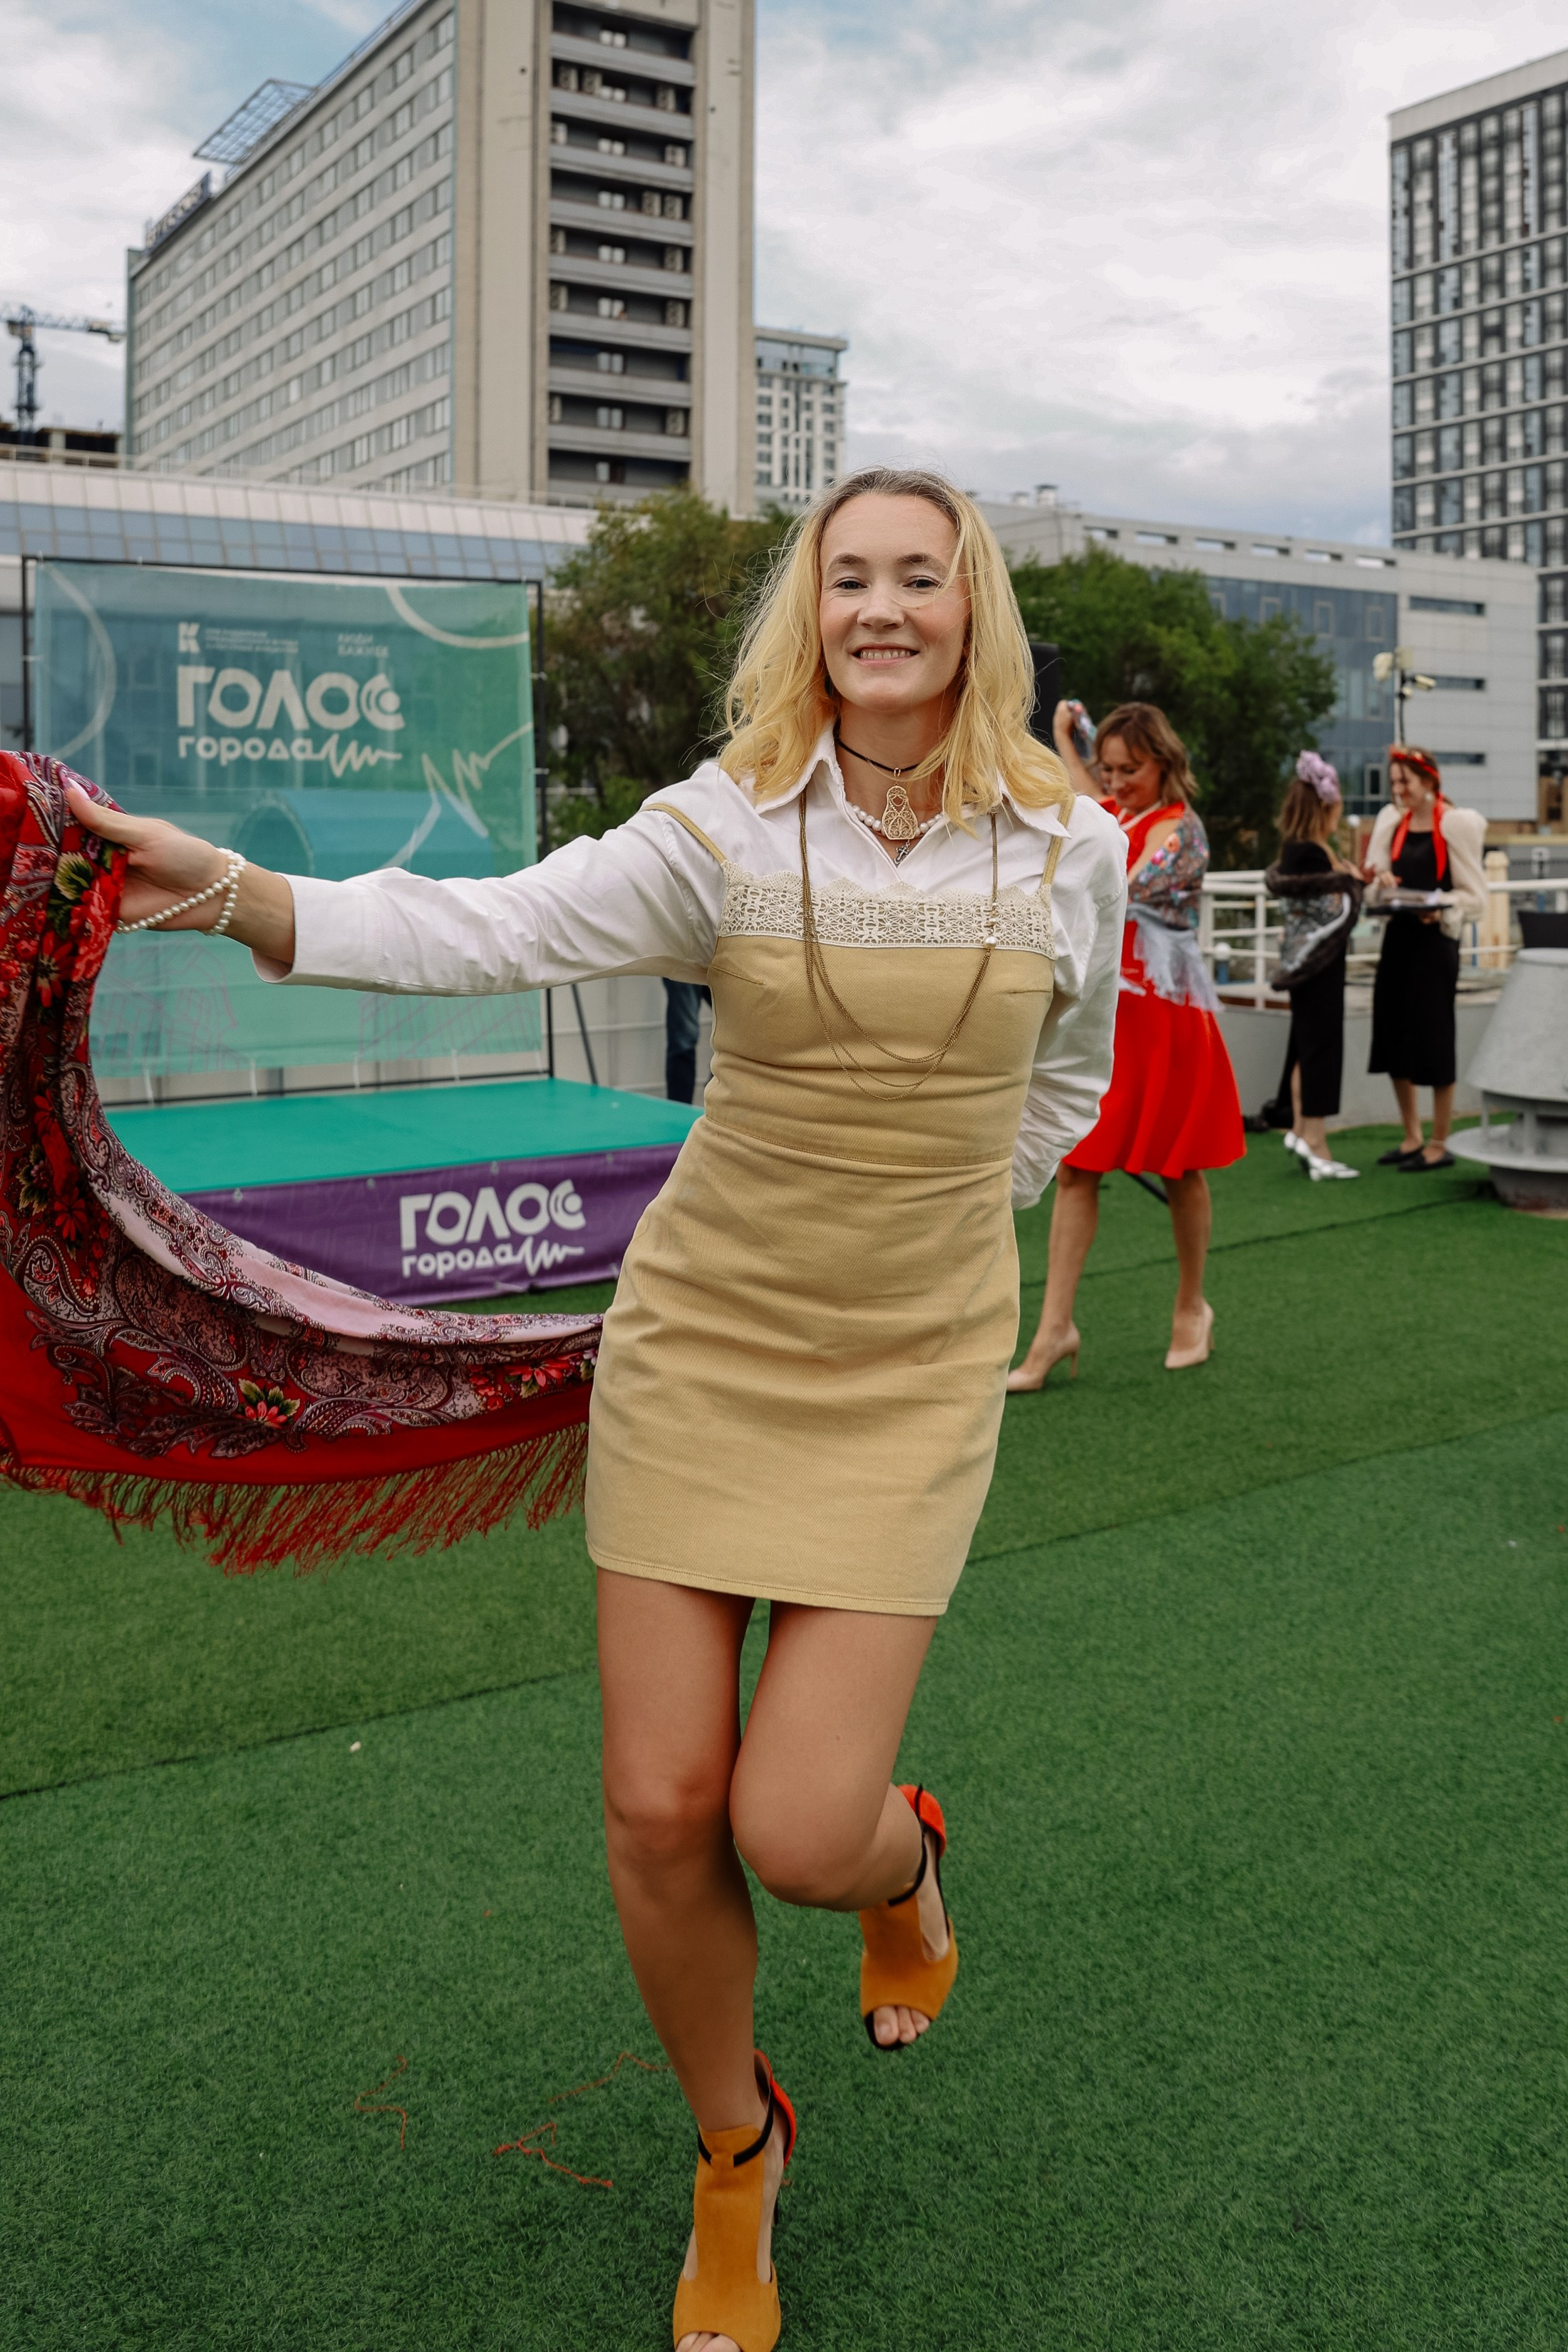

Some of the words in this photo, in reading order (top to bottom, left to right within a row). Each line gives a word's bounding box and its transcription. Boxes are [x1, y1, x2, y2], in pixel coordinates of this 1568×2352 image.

[177, 665, 405, 732] ГОЛОС
[178, 736, 321, 766] города
[400, 1179, 586, 1251] ГОЛОС
[402, 1243, 525, 1280] города
